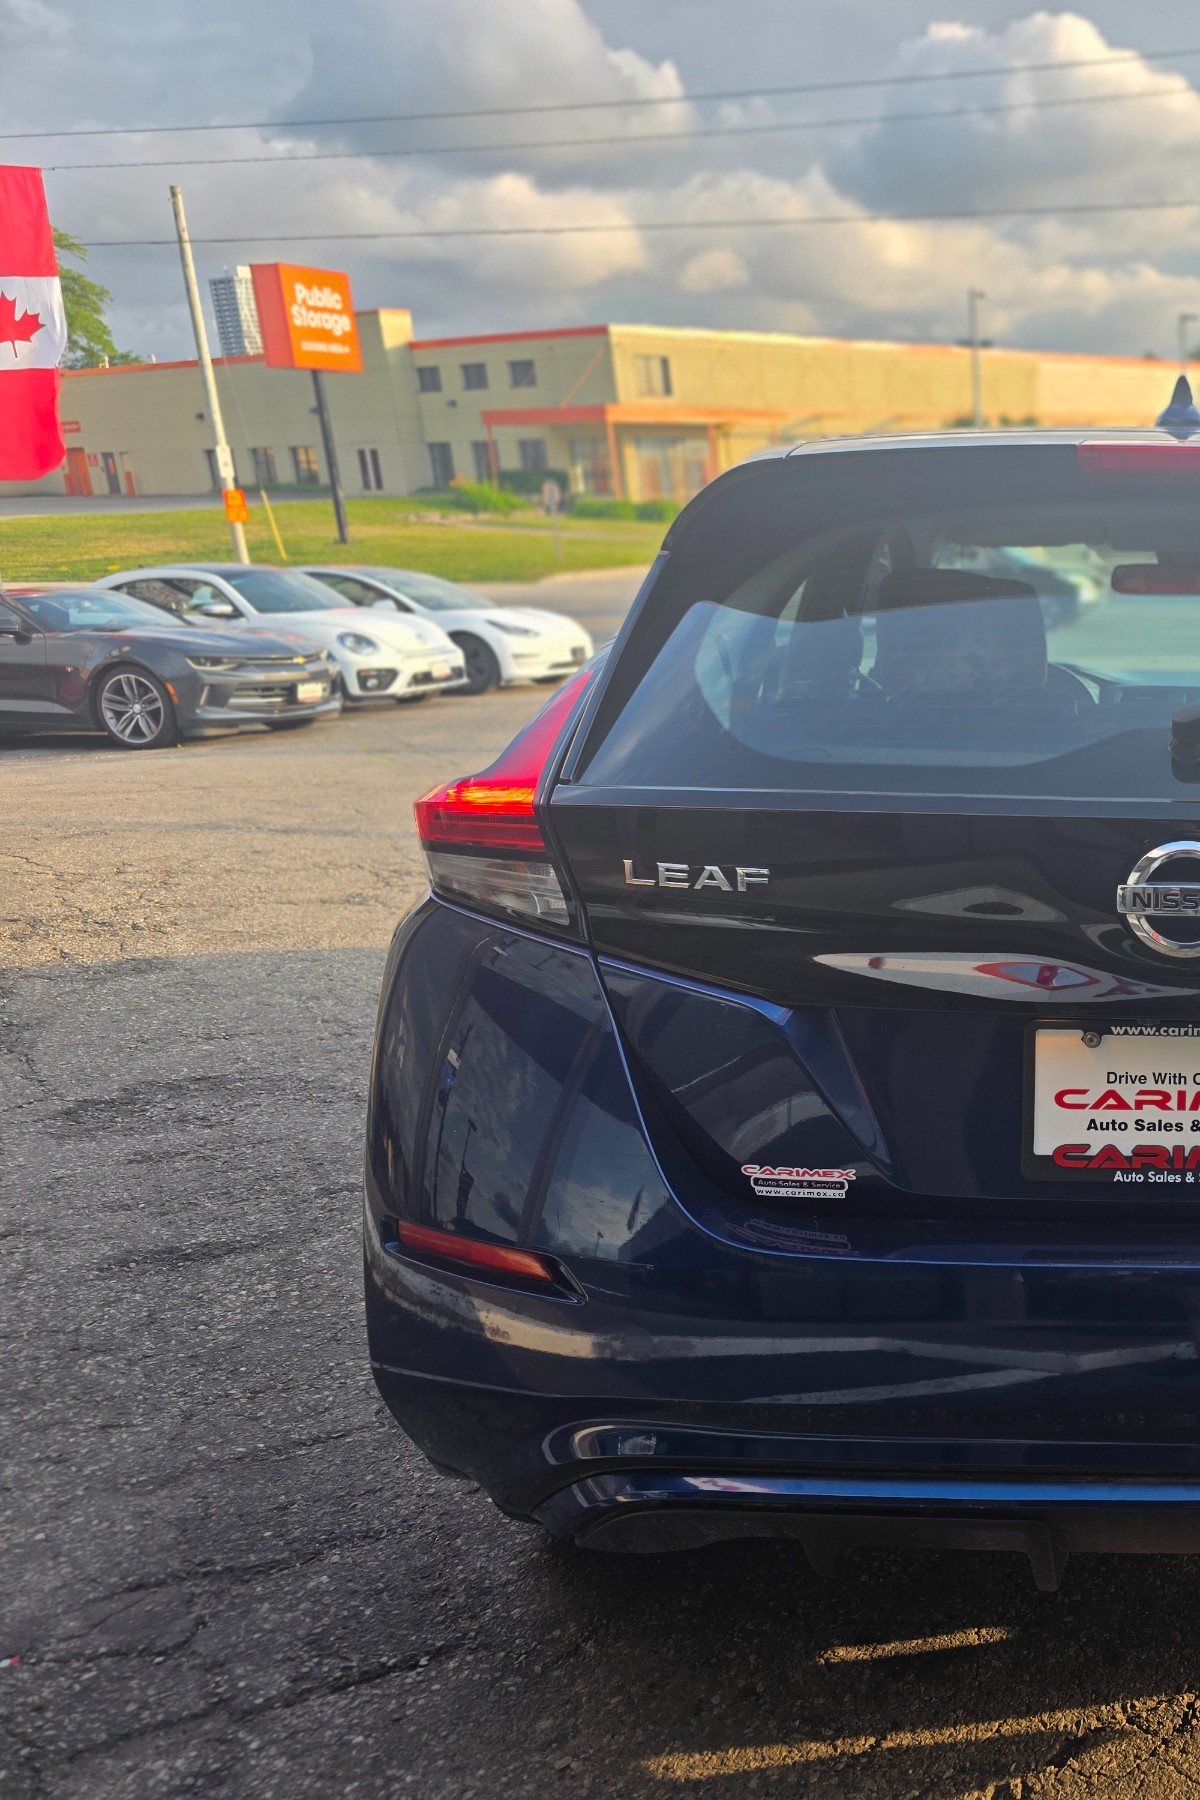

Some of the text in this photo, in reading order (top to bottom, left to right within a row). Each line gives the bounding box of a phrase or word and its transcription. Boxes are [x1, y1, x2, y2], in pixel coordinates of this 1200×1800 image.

[294, 283, 343, 310] Public
[291, 304, 352, 336] Storage
[623, 860, 770, 891] LEAF
[1106, 1071, 1147, 1085] Drive
[1152, 1072, 1187, 1086] With
[1086, 1118, 1128, 1132] Auto
[1134, 1119, 1184, 1132] Sales
[742, 1165, 855, 1179] CARIMEX
[1113, 1170, 1144, 1183] Auto
[1147, 1171, 1181, 1183] Sales
[1185, 1172, 1195, 1183] &
[757, 1179, 777, 1187] Auto
[779, 1180, 800, 1188] Sales
[756, 1189, 844, 1198] www.carimex.ca
